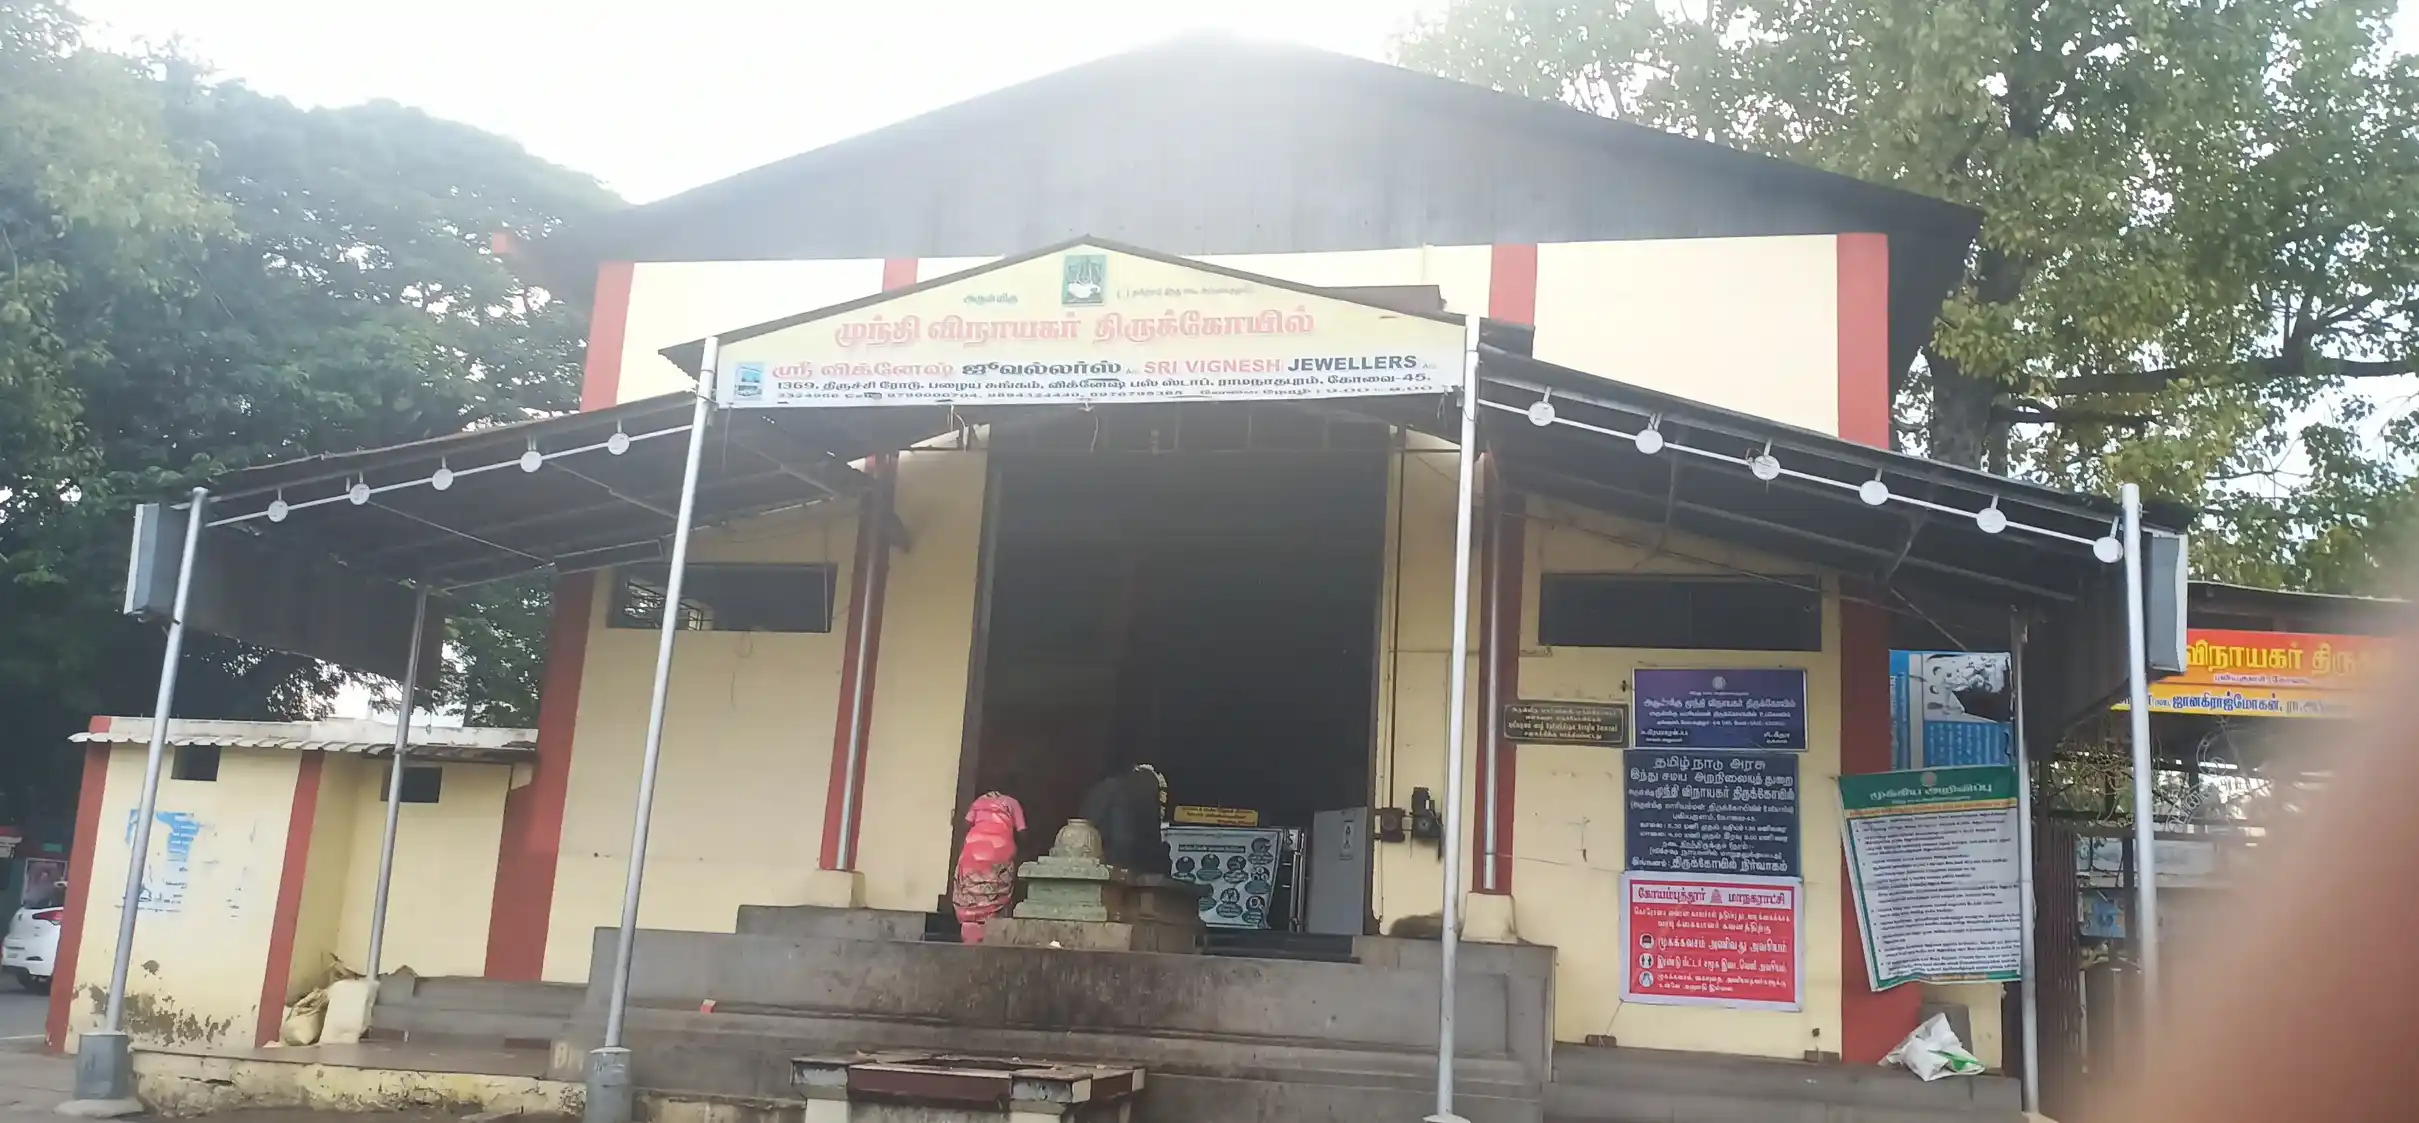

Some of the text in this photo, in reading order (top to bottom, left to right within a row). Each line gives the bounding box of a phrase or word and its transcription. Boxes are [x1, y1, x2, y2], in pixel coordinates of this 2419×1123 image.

[834, 305, 1315, 347] முந்தி விநாயகர் திருக்கோயில்
[772, 361, 813, 378] ஸ்ரீ
[821, 361, 955, 378] விக்னேஷ்
[962, 361, 1122, 376] ஜூவல்லர்ஸ்
[1144, 360, 1179, 375] SRI
[1186, 358, 1281, 374] VIGNESH
[1288, 355, 1418, 372] JEWELLERS
[822, 380, 876, 391] திருச்சி
[929, 381, 981, 391] பழைய
[1049, 379, 1126, 390] விக்னேஷ்
[1130, 378, 1159, 388] பஸ்
[2185, 639, 2304, 673] விநாயகர்
[1652, 756, 1767, 771] தமிழ் நாடு அரசு
[1630, 767, 1659, 782] இந்து
[1662, 773, 1688, 782] சமய
[1655, 784, 1680, 799] முந்தி
[1682, 785, 1730, 800] விநாயகர்
[1740, 859, 1788, 873] நிர்வாகம்
[1637, 886, 1786, 905] கோயம்புத்தூர் மாநகராட்சி
[1657, 936, 1788, 954] முகக்கவசம் அணிவது அவசியம்
